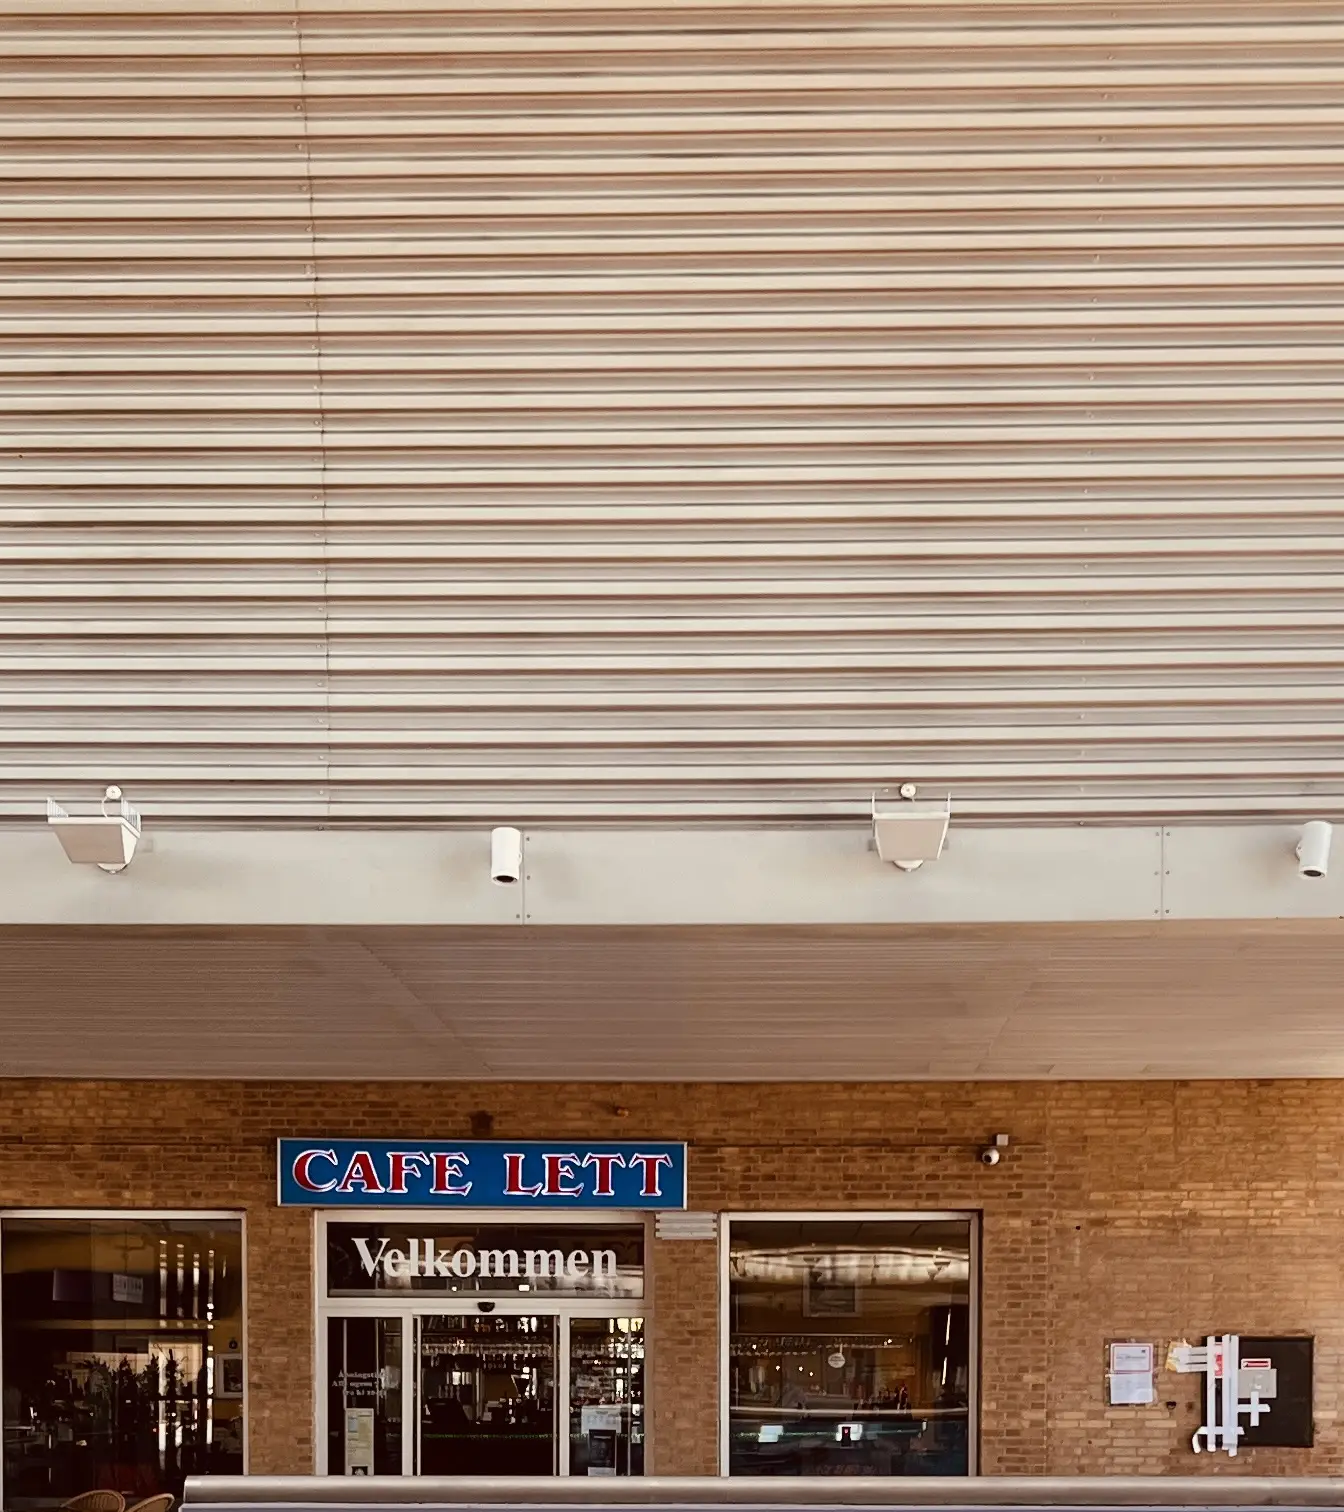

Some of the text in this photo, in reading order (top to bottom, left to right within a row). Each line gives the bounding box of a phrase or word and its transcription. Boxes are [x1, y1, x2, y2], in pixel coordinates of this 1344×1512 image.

[292, 1149, 674, 1197] CAFE LETT
[351, 1237, 618, 1278] Velkommen
